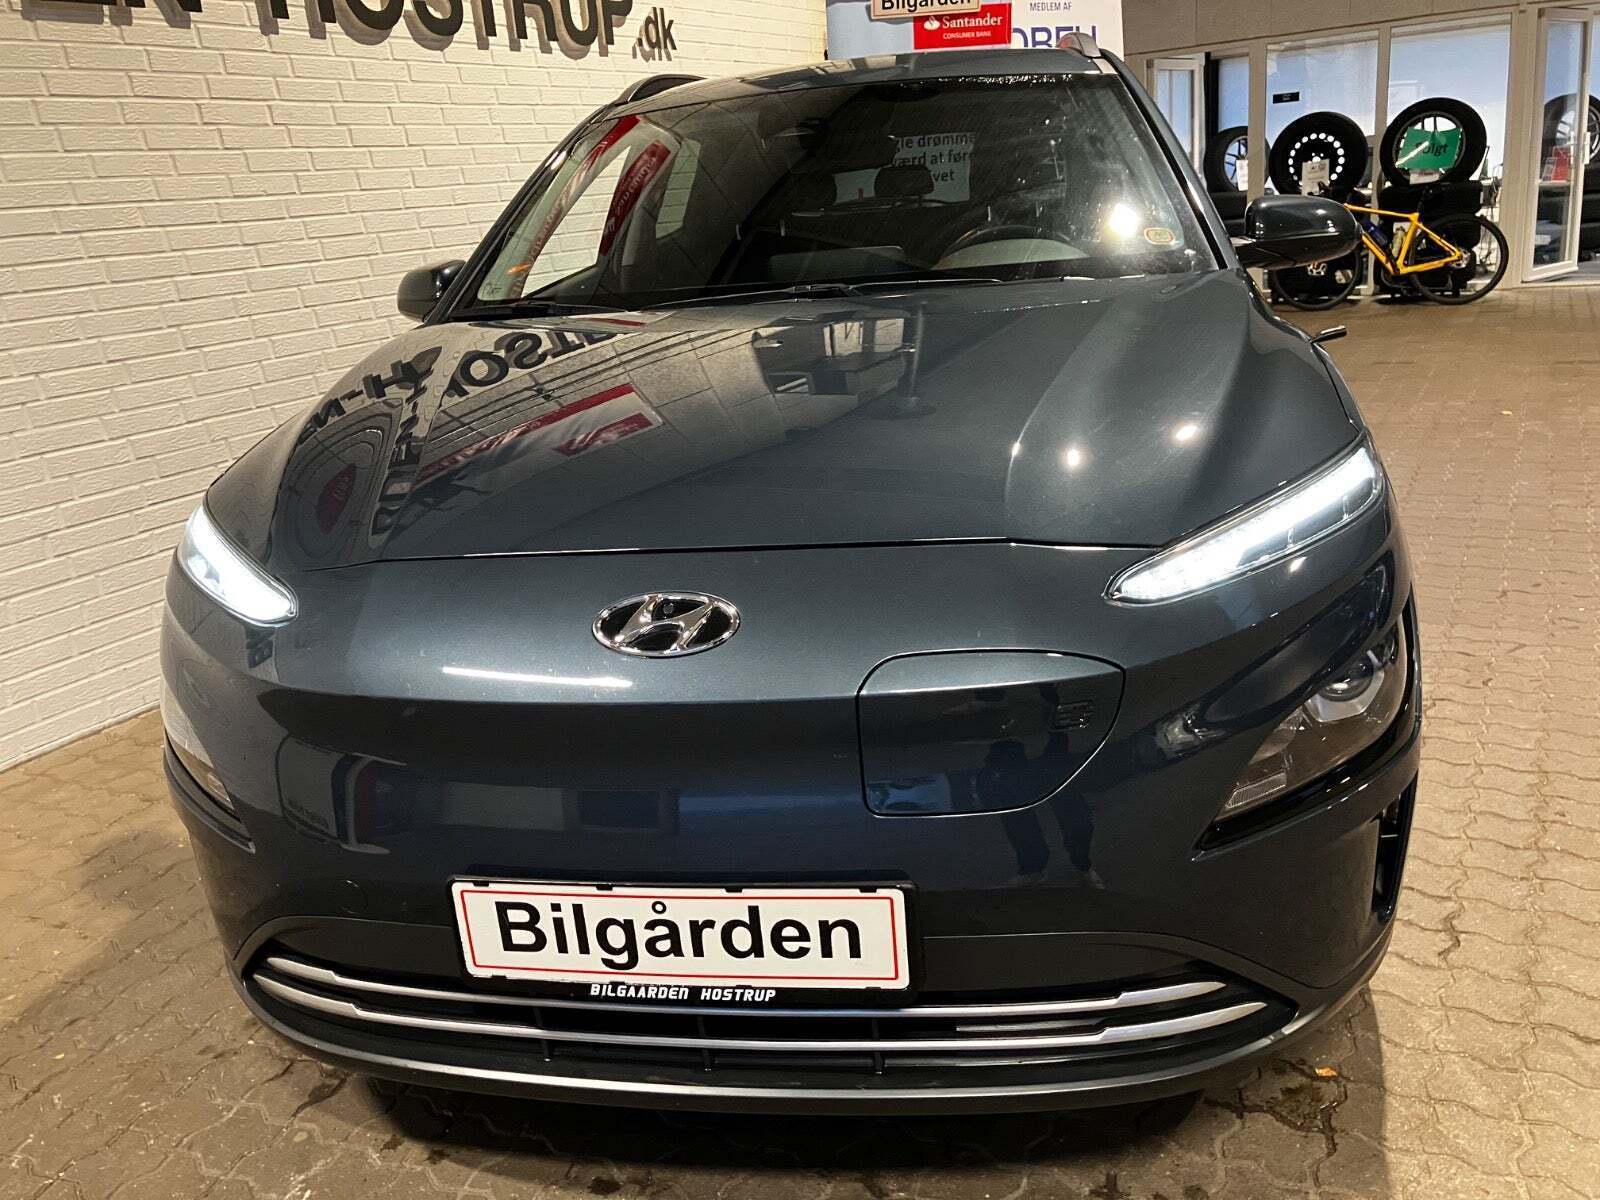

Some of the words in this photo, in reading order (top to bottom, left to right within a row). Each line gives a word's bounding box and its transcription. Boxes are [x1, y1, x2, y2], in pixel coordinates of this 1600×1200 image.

[1029, 2, 1060, 11] MEDLEM
[1063, 2, 1073, 11] AF
[942, 12, 1003, 29] Santander
[930, 169, 955, 182] vet
[494, 900, 862, 971] Bilgården
[590, 983, 689, 1000] BILGAARDEN
[701, 989, 777, 1002] HOSTRUP
